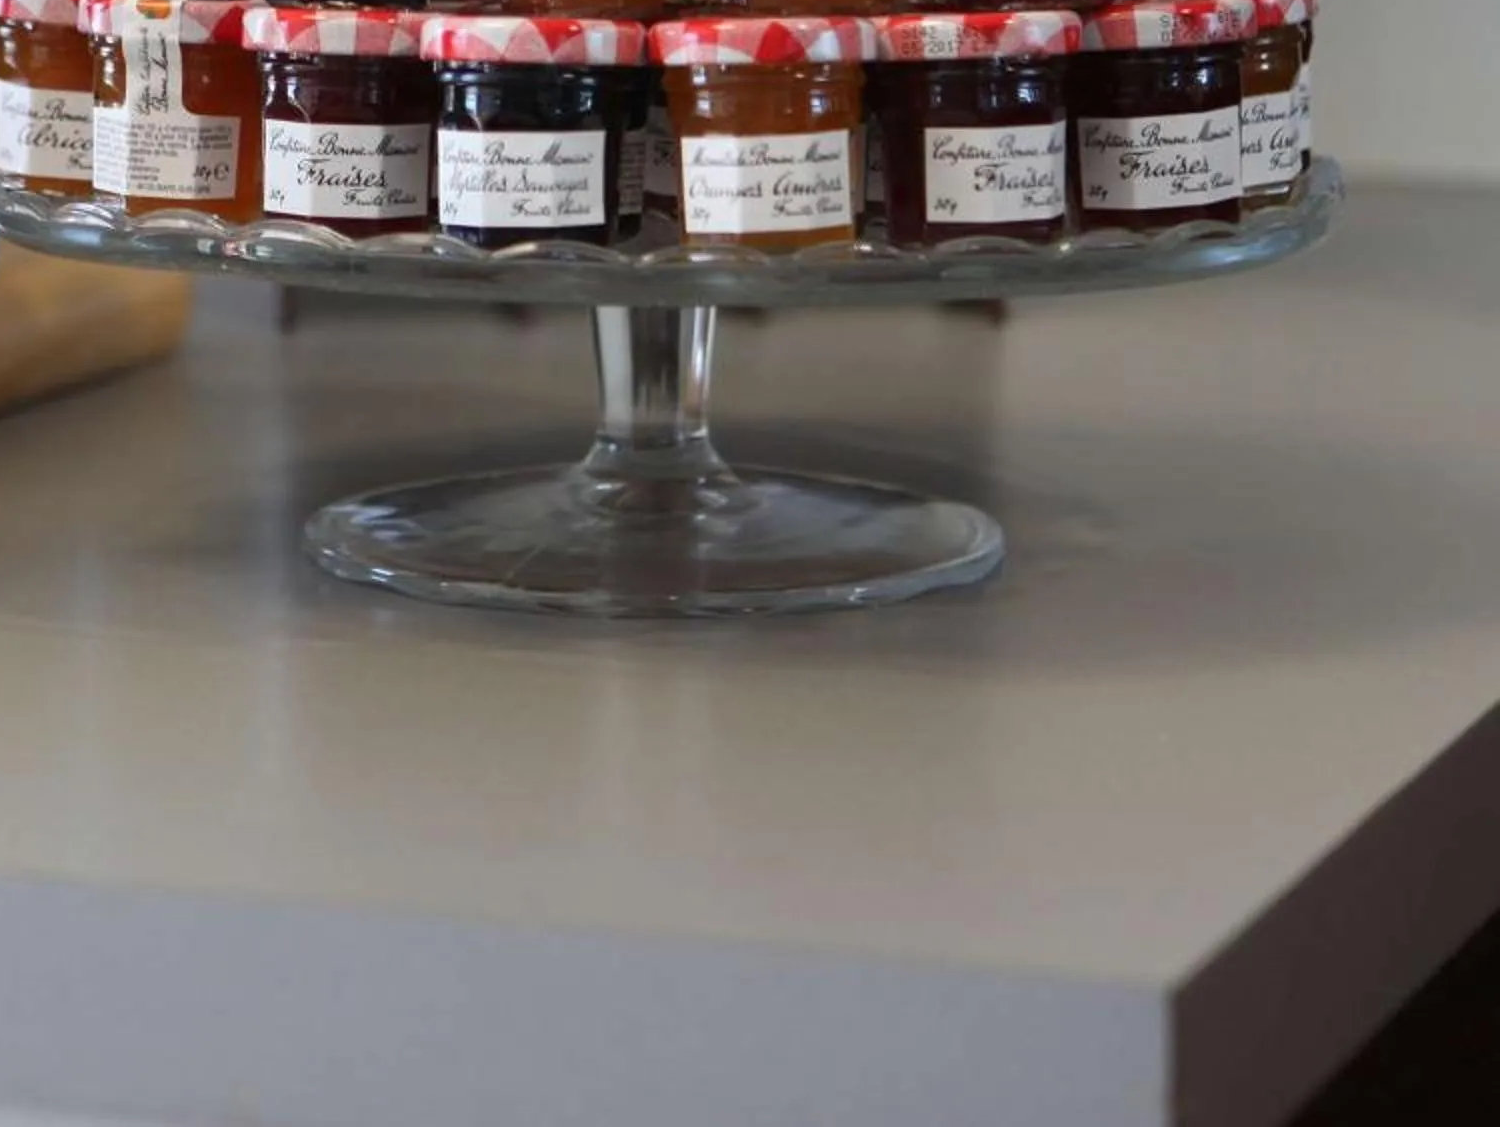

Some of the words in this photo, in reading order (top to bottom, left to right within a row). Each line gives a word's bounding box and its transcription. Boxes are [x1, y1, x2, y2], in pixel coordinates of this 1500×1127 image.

[17, 123, 93, 151] Abrico
[317, 130, 364, 157] Bonne
[1139, 122, 1189, 149] Bonne
[297, 158, 388, 189] Fraises
[974, 162, 1055, 192] Fraises
[1119, 150, 1212, 181] Fraises
